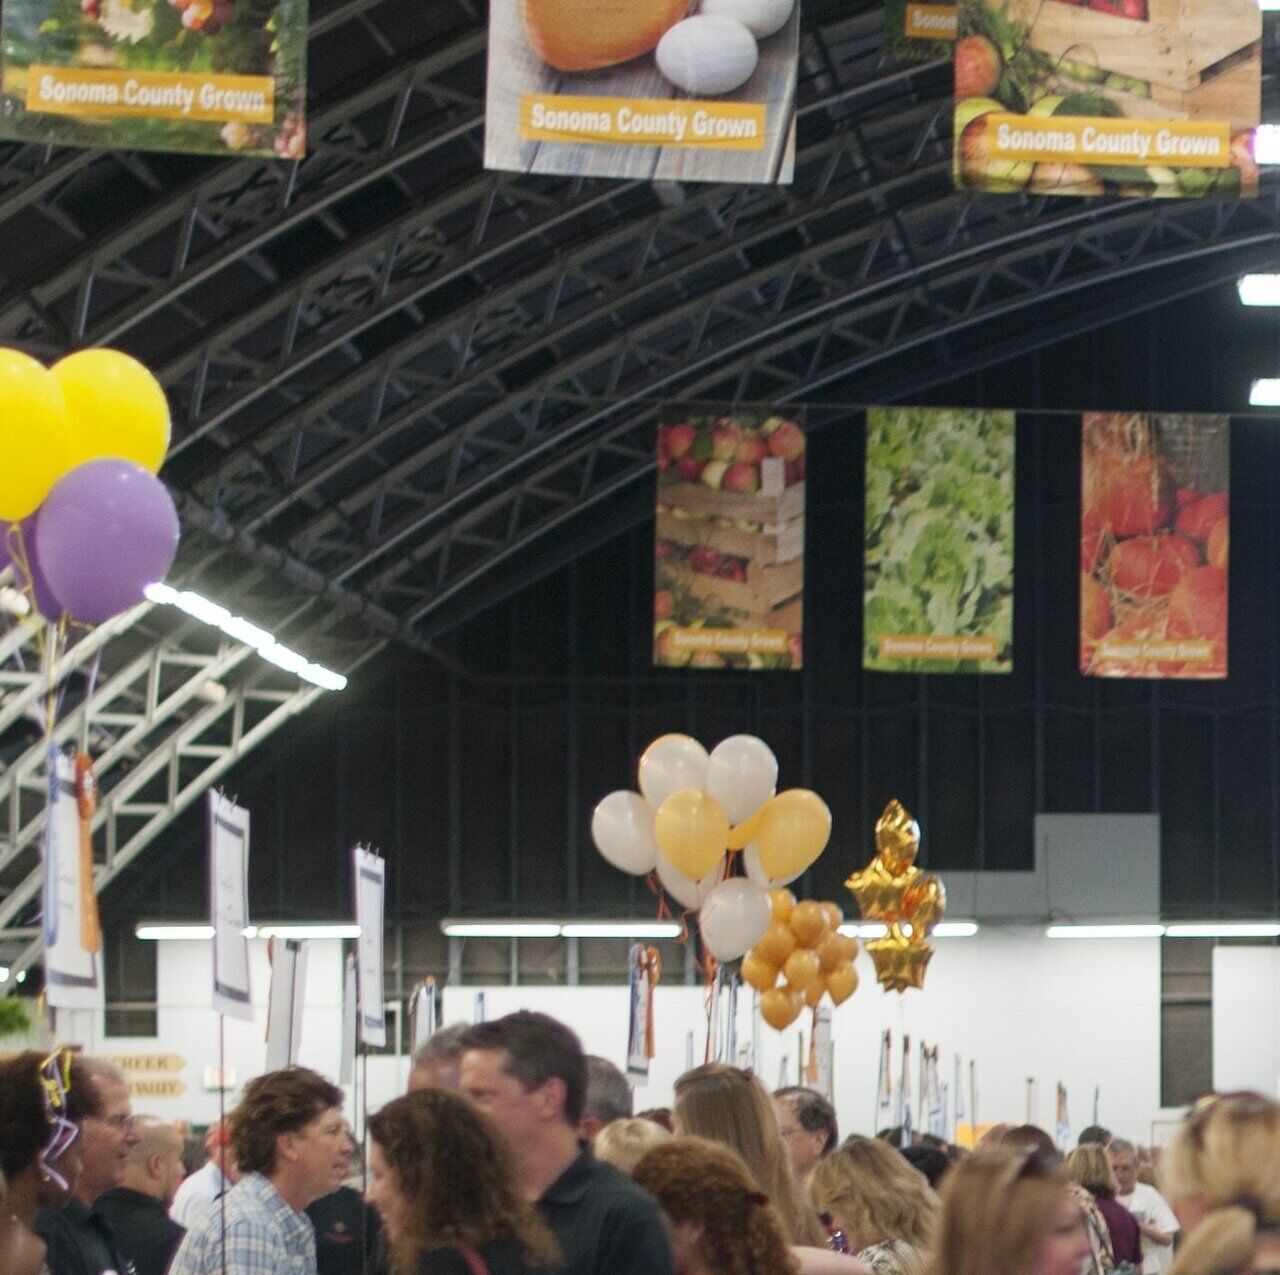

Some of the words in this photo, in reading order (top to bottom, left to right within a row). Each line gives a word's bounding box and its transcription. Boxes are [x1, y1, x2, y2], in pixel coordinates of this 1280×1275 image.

[40, 74, 119, 105] Sonoma
[124, 78, 195, 116] County
[200, 82, 266, 113] Grown
[531, 102, 612, 133] Sonoma
[616, 106, 688, 142] County
[692, 109, 757, 139] Grown
[997, 123, 1076, 153] Sonoma
[1081, 125, 1153, 160] County
[1156, 128, 1220, 156] Grown
